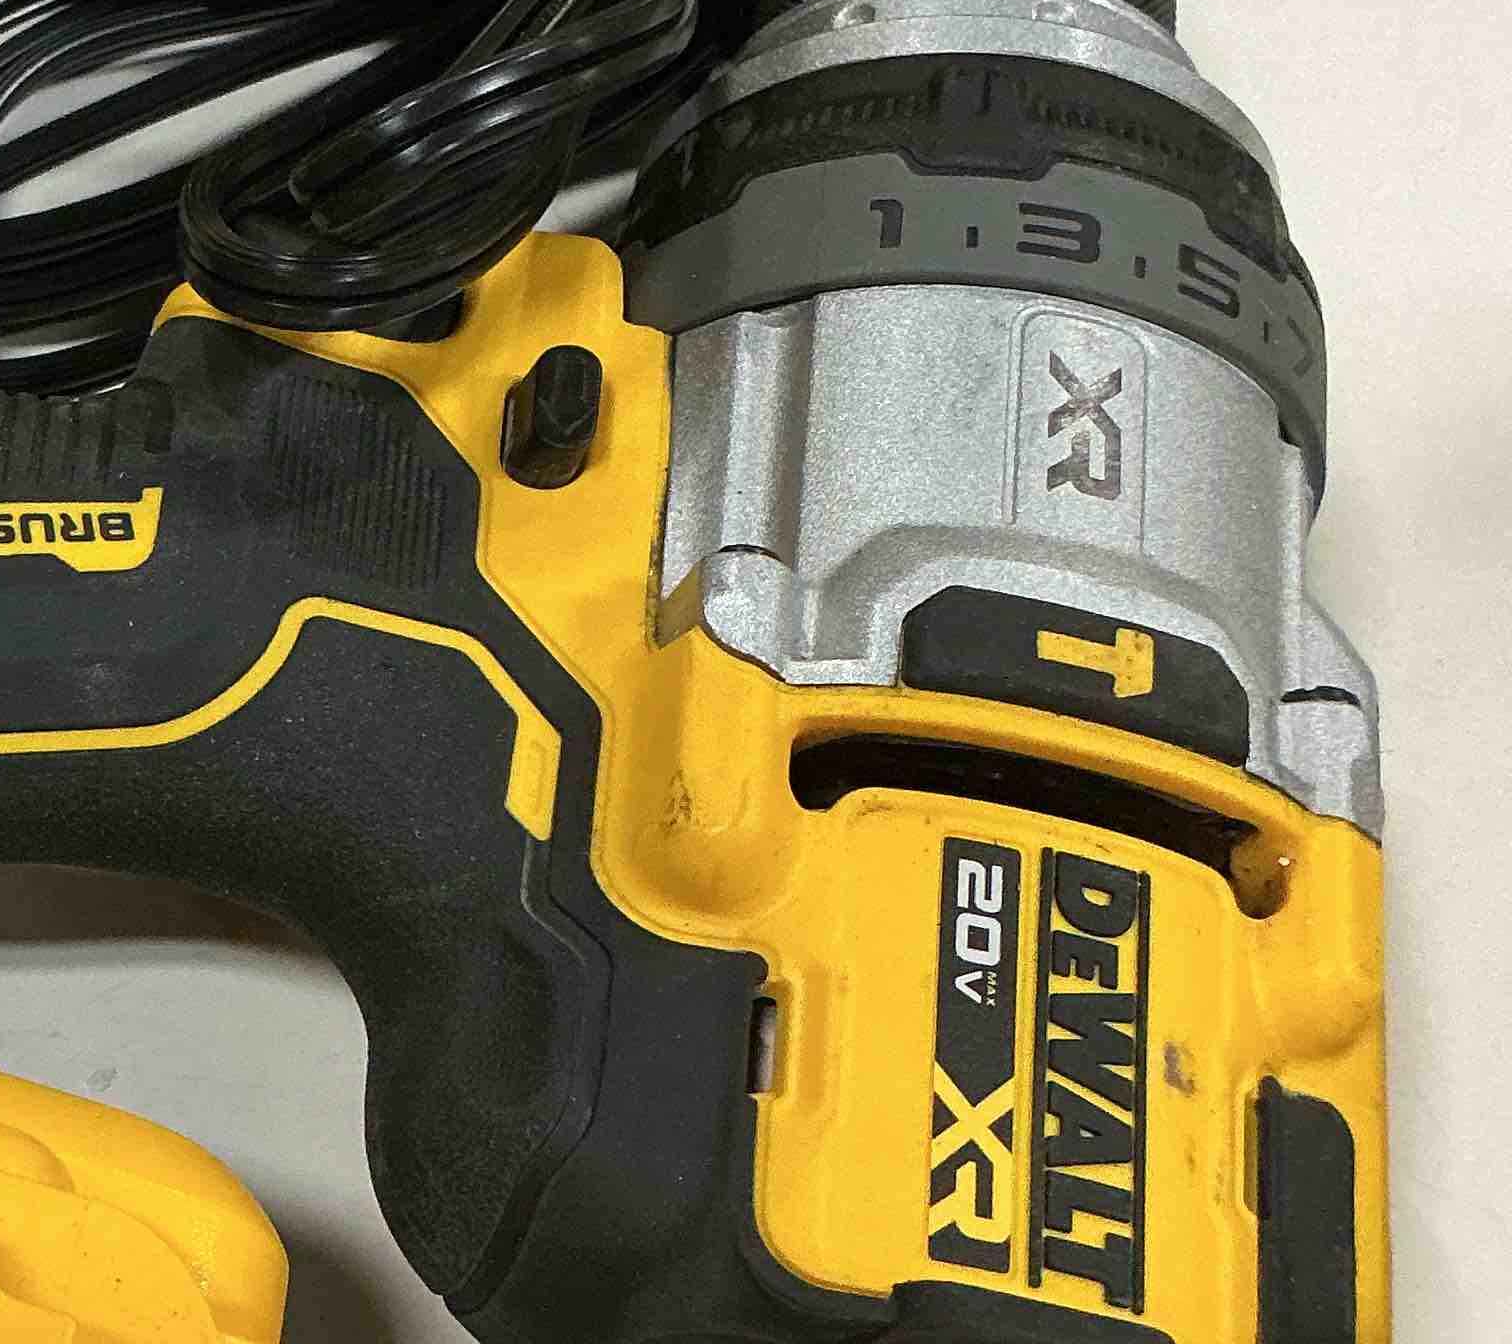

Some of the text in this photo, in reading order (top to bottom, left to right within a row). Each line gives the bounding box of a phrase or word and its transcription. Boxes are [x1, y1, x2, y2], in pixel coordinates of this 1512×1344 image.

[870, 198, 904, 249] 1
[1016, 202, 1101, 264] 3
[1177, 243, 1241, 319] 5
[1046, 350, 1122, 501] XR
[928, 857, 1014, 1248] 20V MAX XR
[1044, 850, 1141, 1310] DEWALT
